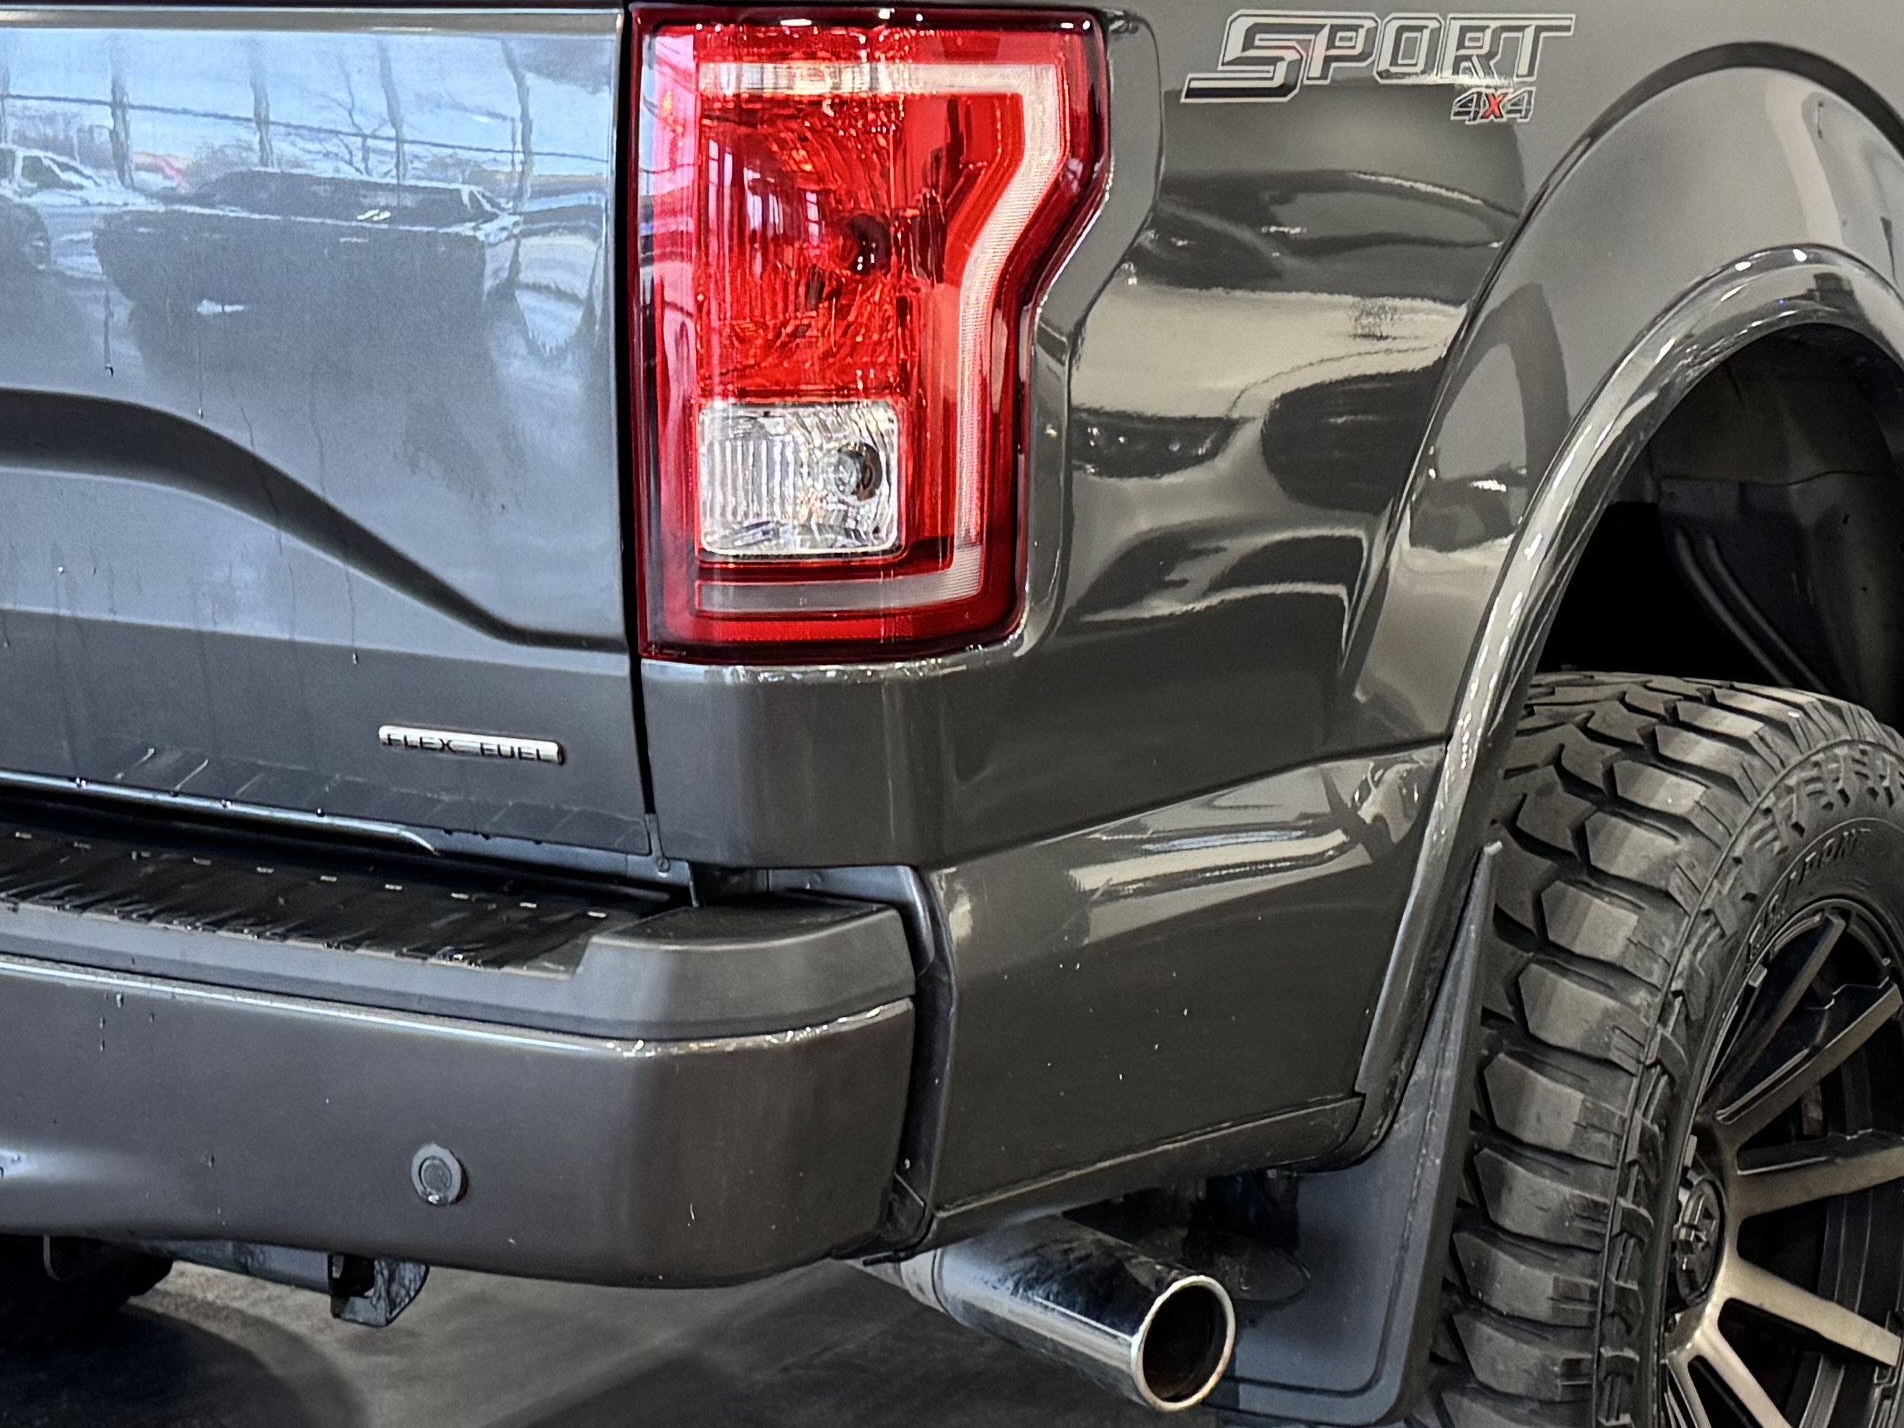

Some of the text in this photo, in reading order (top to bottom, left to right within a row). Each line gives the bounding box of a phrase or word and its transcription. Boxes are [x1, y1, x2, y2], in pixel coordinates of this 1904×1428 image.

[1180, 9, 1576, 103] SPORT
[382, 732, 559, 762] FLEX FUEL
